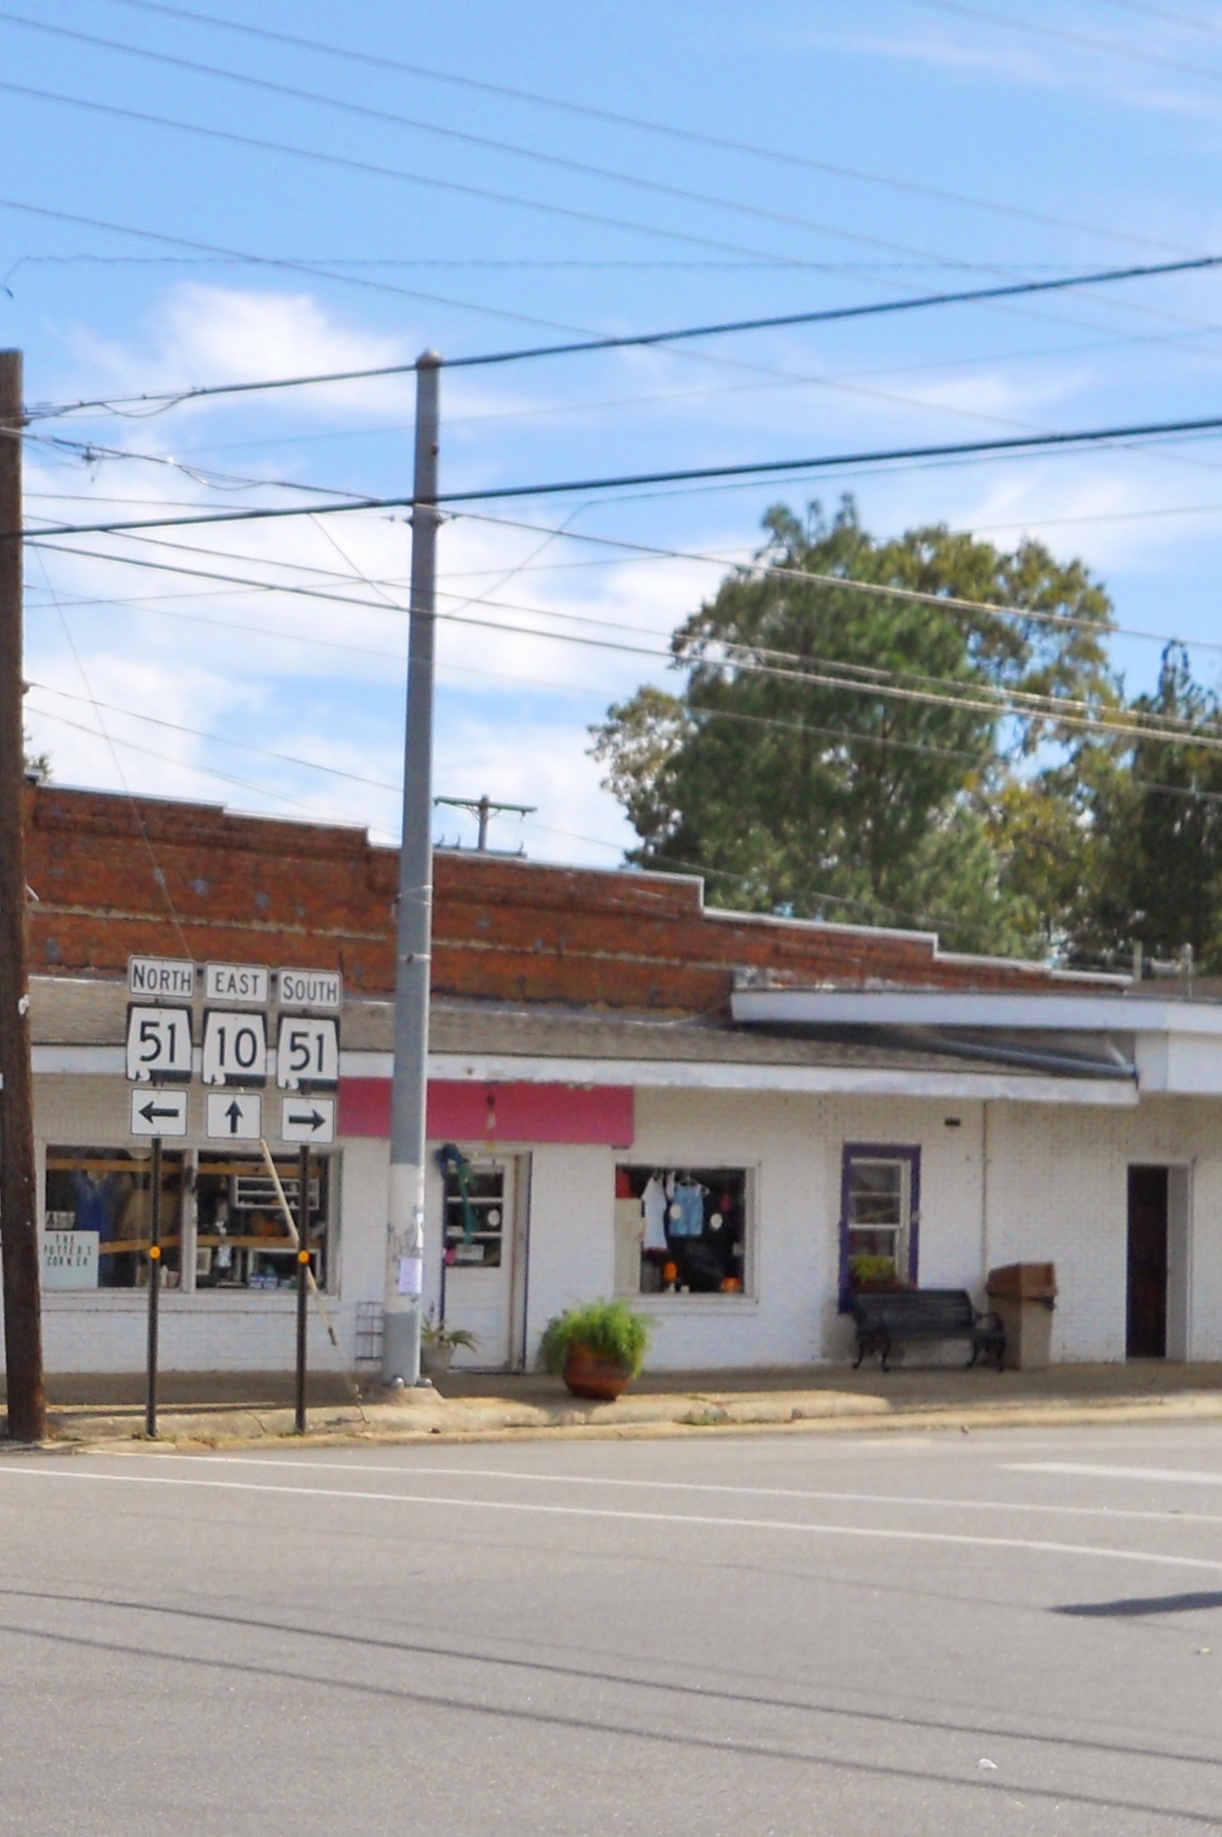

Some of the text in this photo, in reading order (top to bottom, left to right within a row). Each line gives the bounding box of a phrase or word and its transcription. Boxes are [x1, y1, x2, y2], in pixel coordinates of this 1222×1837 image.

[133, 965, 192, 992] NORTH
[215, 971, 260, 996] EAST
[283, 975, 338, 1002] SOUTH
[139, 1020, 176, 1063] 51
[217, 1026, 258, 1068] 10
[290, 1031, 325, 1073] 51
[55, 1234, 75, 1245] THE
[46, 1256, 88, 1267] CORNER
